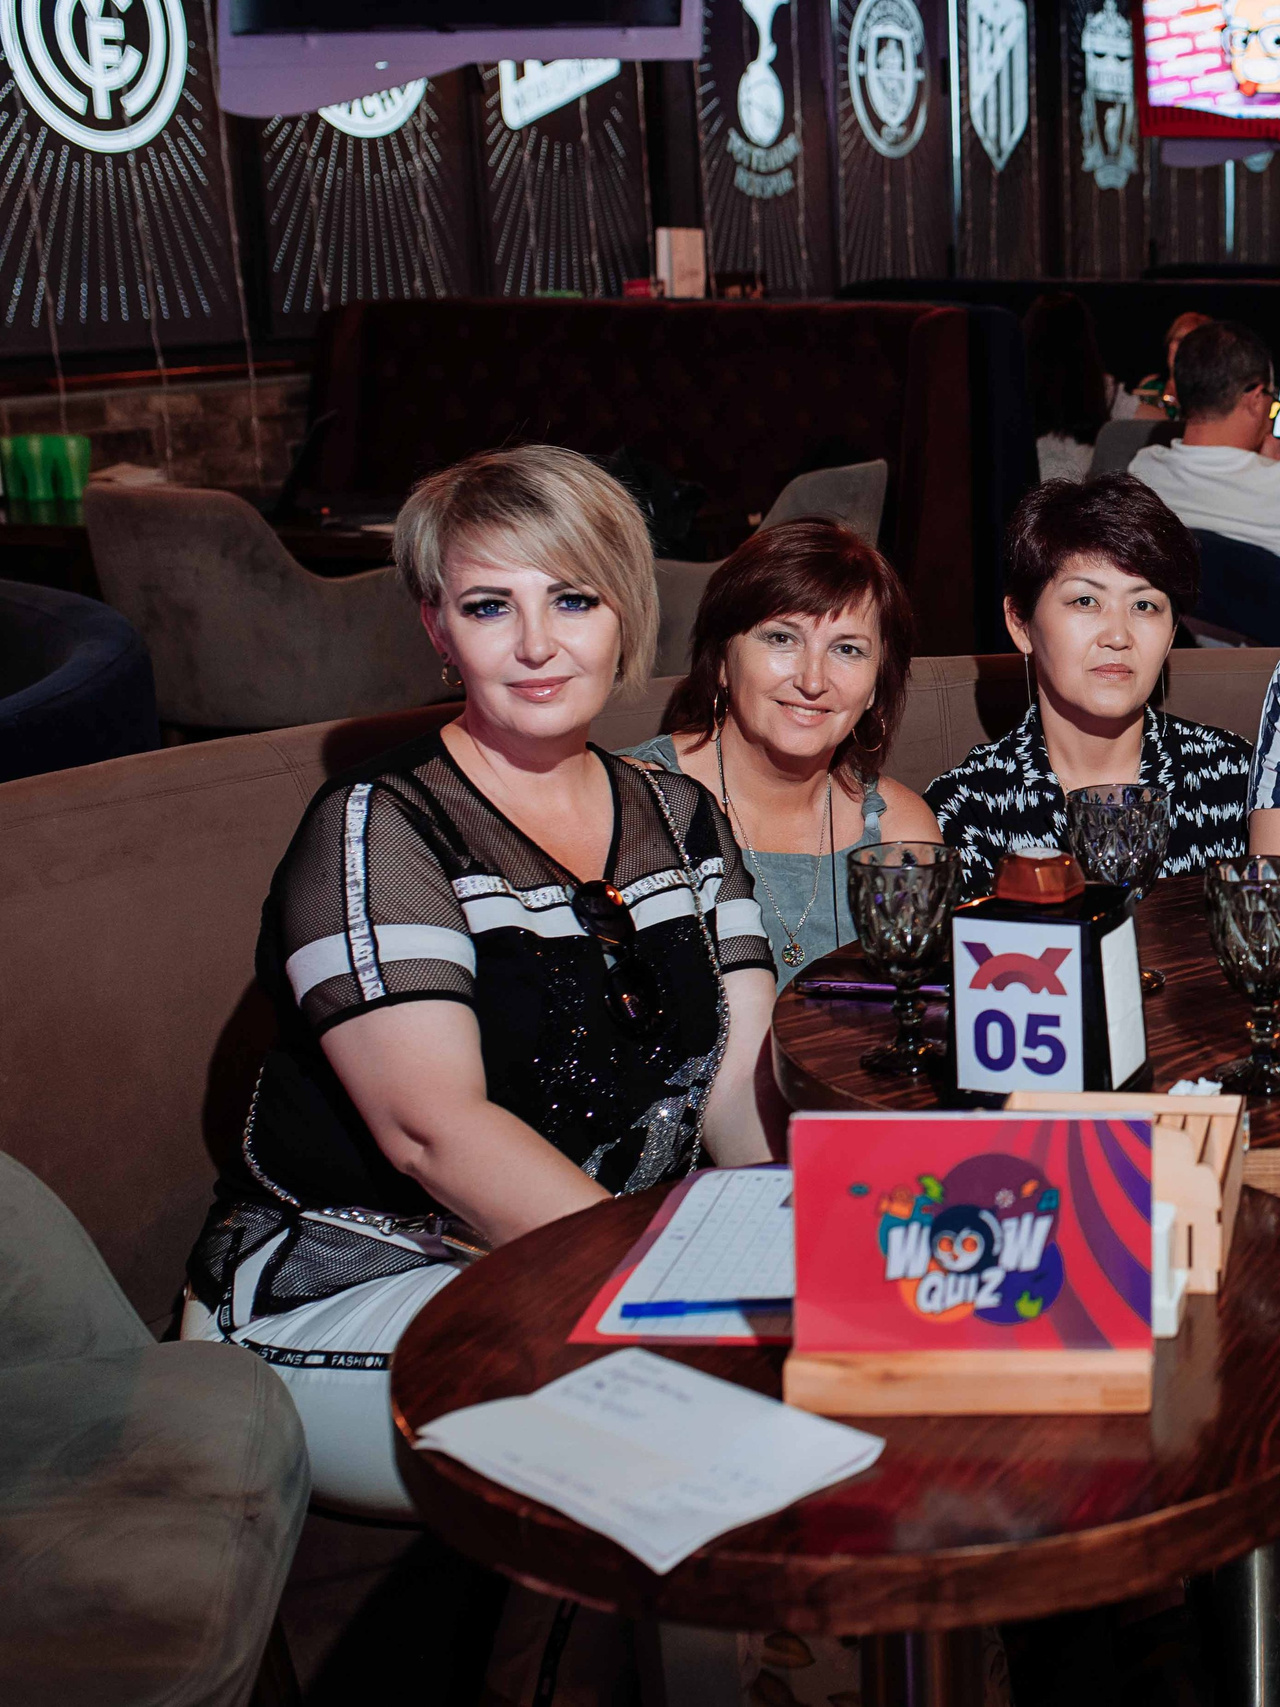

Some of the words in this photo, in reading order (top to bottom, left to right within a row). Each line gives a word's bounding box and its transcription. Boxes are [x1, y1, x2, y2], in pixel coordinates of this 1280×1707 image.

[648, 869, 684, 891] LOVE
[974, 1008, 1067, 1076] 05
[885, 1204, 1053, 1281] WOW
[916, 1266, 1006, 1314] QUIZ
[331, 1354, 384, 1368] FASHION
